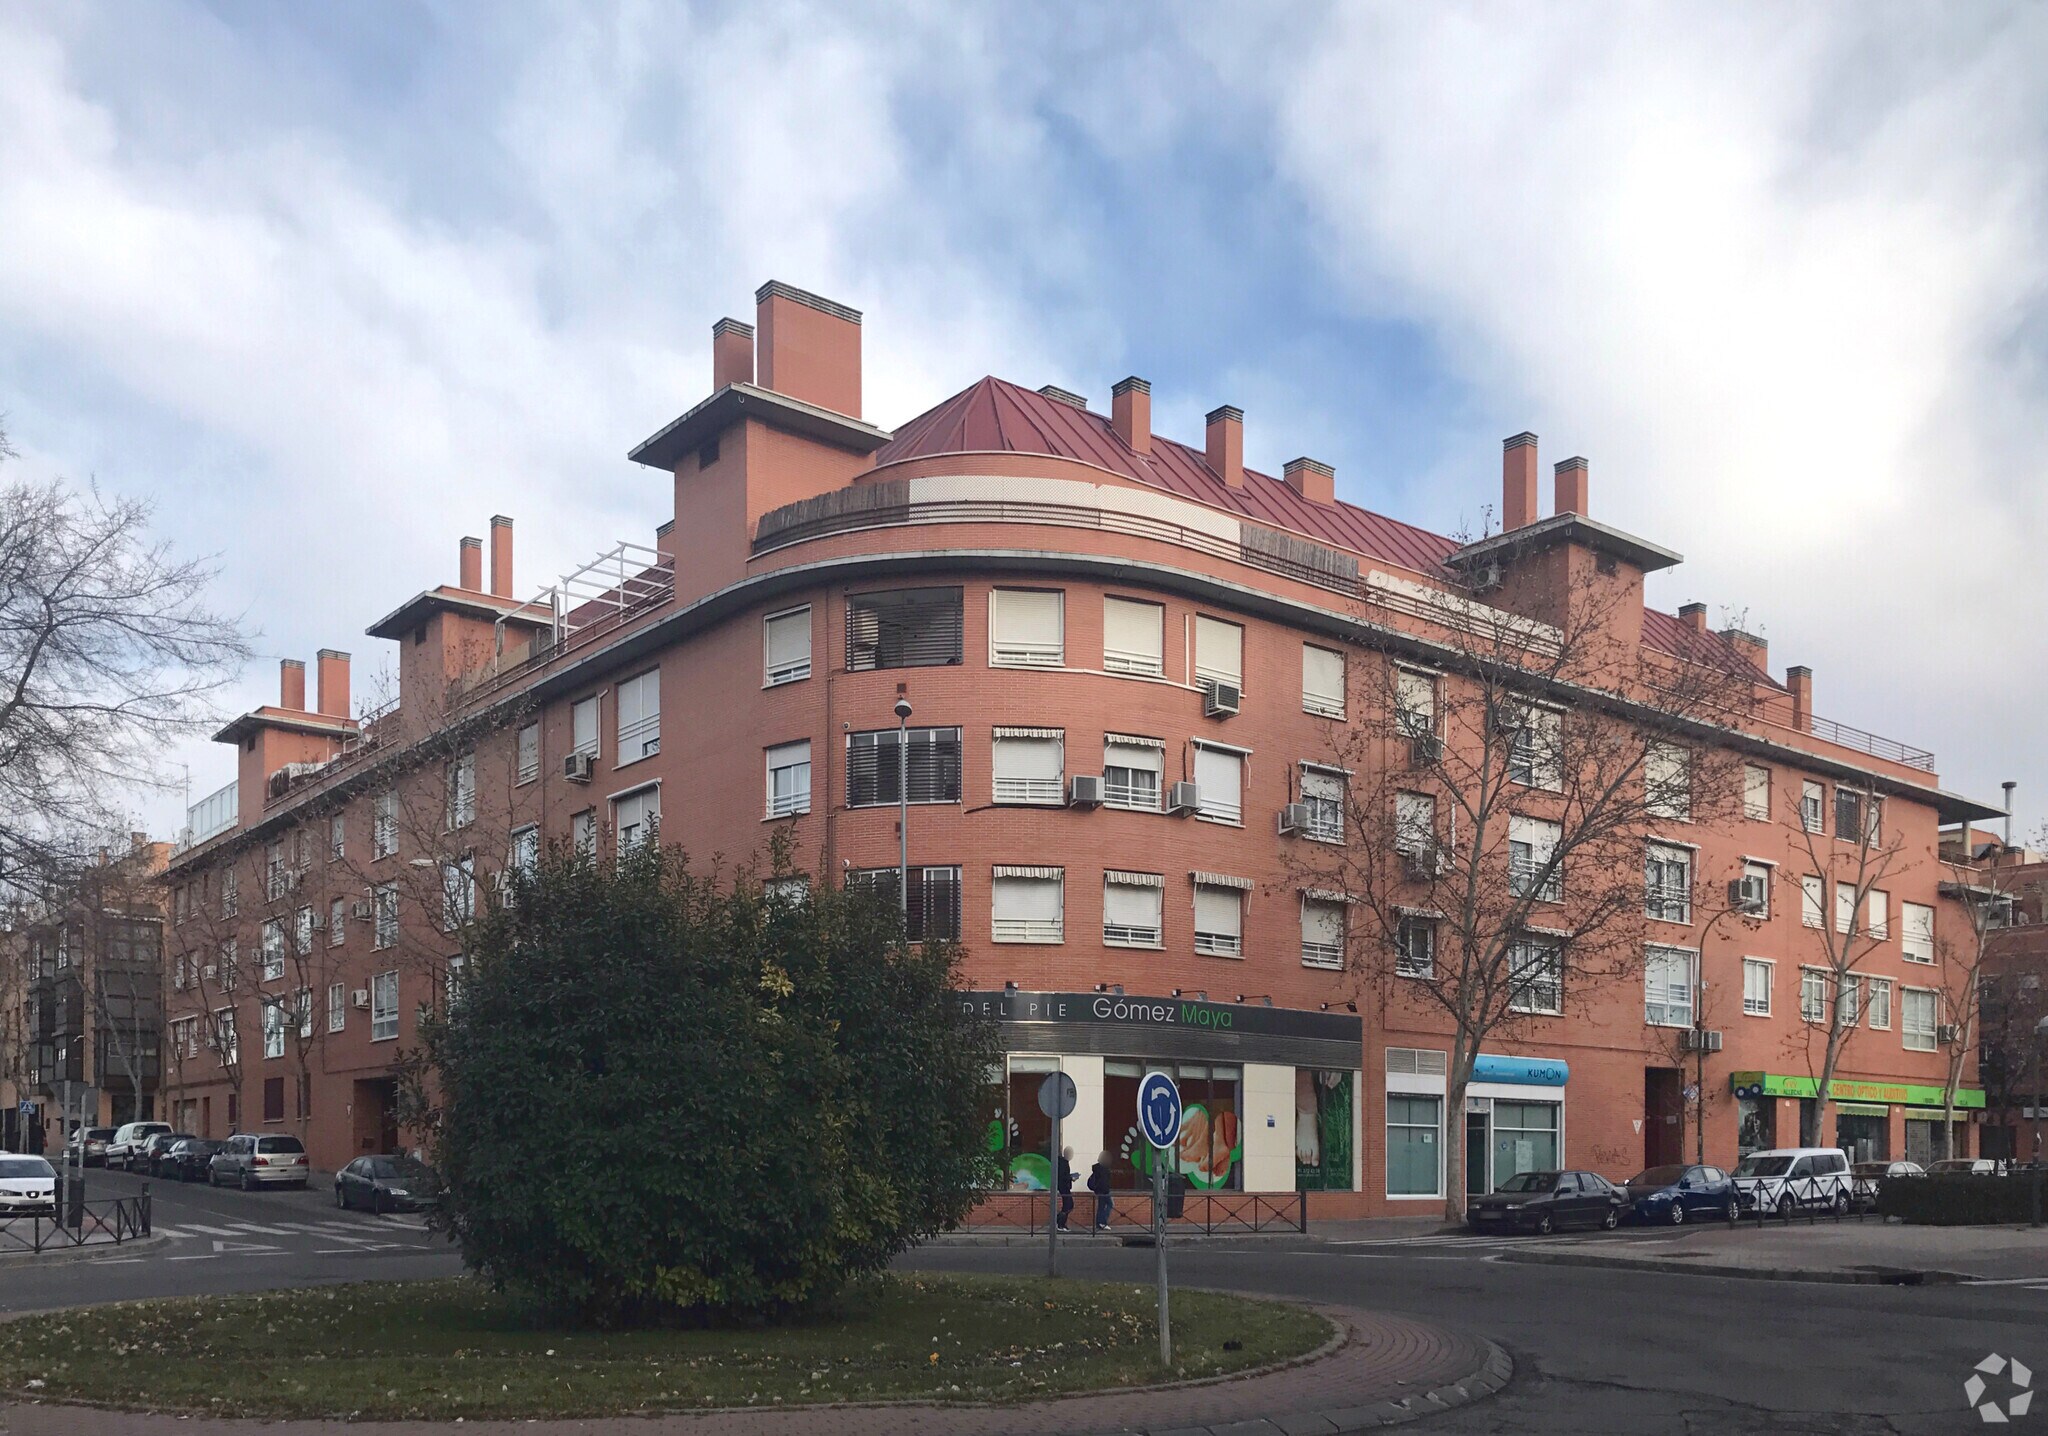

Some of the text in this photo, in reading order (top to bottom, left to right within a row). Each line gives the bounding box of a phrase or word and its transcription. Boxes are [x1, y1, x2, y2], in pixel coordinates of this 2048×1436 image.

[963, 1002, 1067, 1017] DEL PIE
[1093, 997, 1232, 1030] Gómez Maya
[1527, 1067, 1562, 1080] KUMON
[1833, 1083, 1854, 1098] CENTRO
